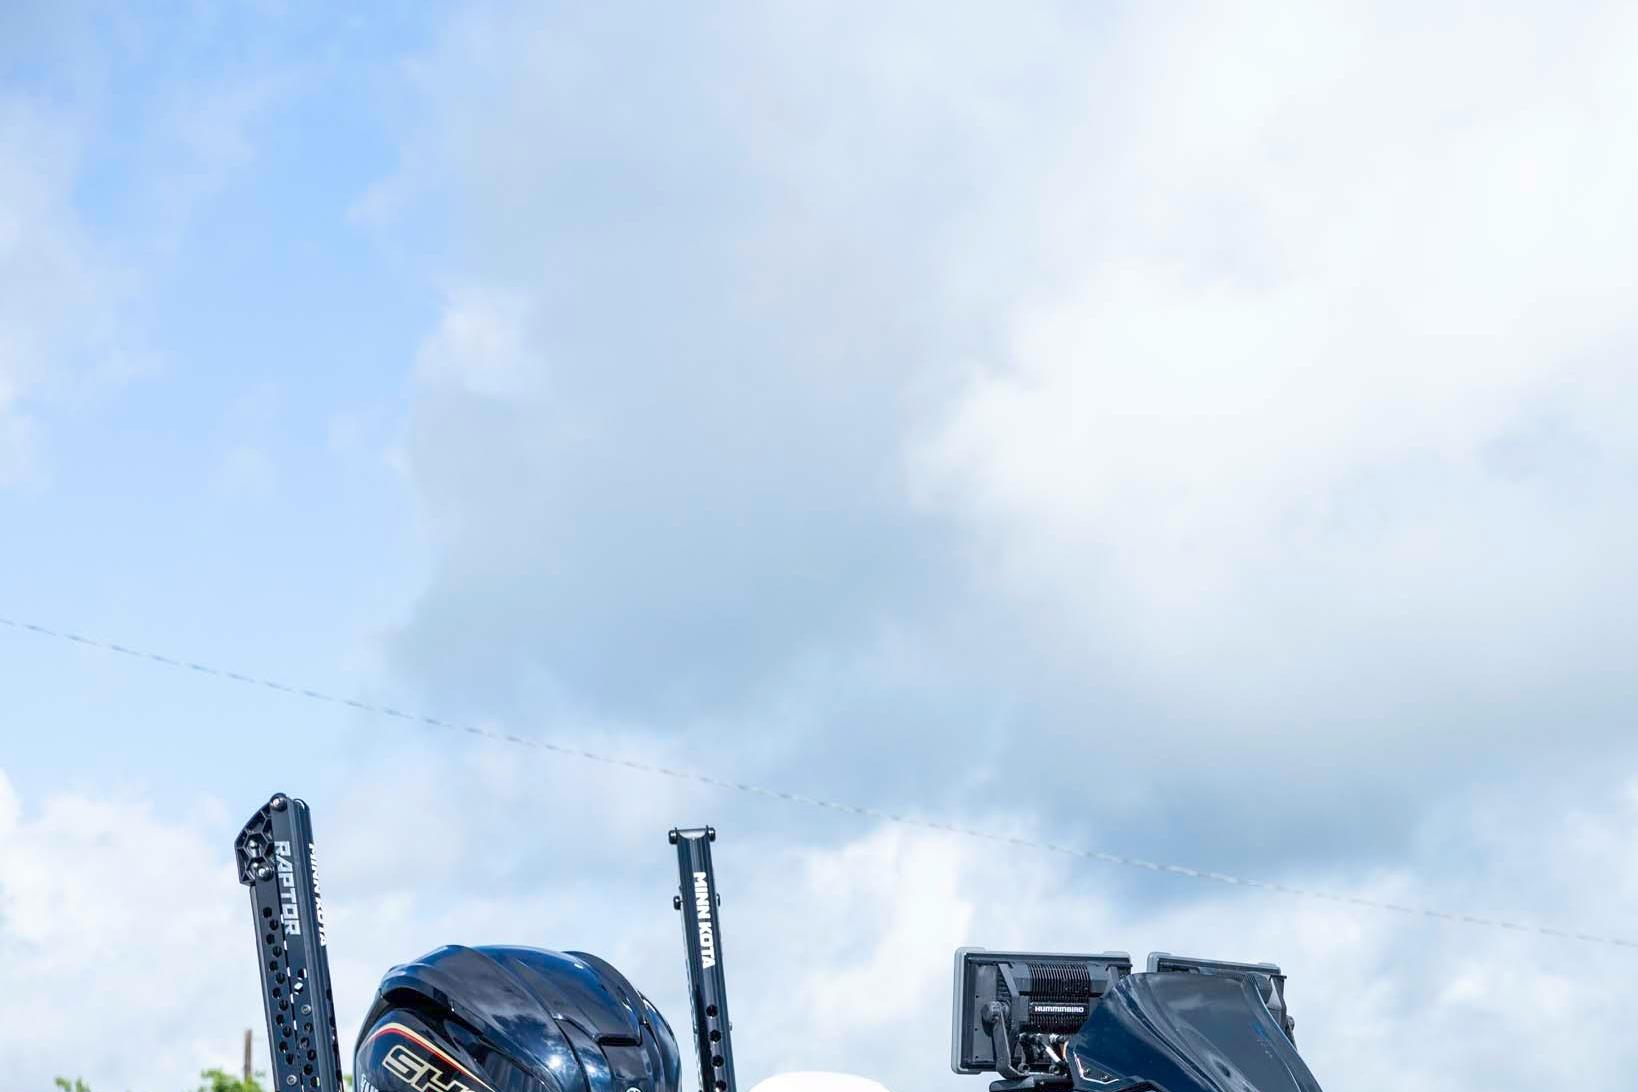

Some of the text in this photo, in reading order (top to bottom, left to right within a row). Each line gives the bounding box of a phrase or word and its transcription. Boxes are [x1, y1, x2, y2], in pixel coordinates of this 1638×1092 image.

[274, 840, 301, 935] RAPTOR
[693, 871, 716, 969] MINN KOTA
[1034, 1005, 1085, 1013] HUMMINBIRD
